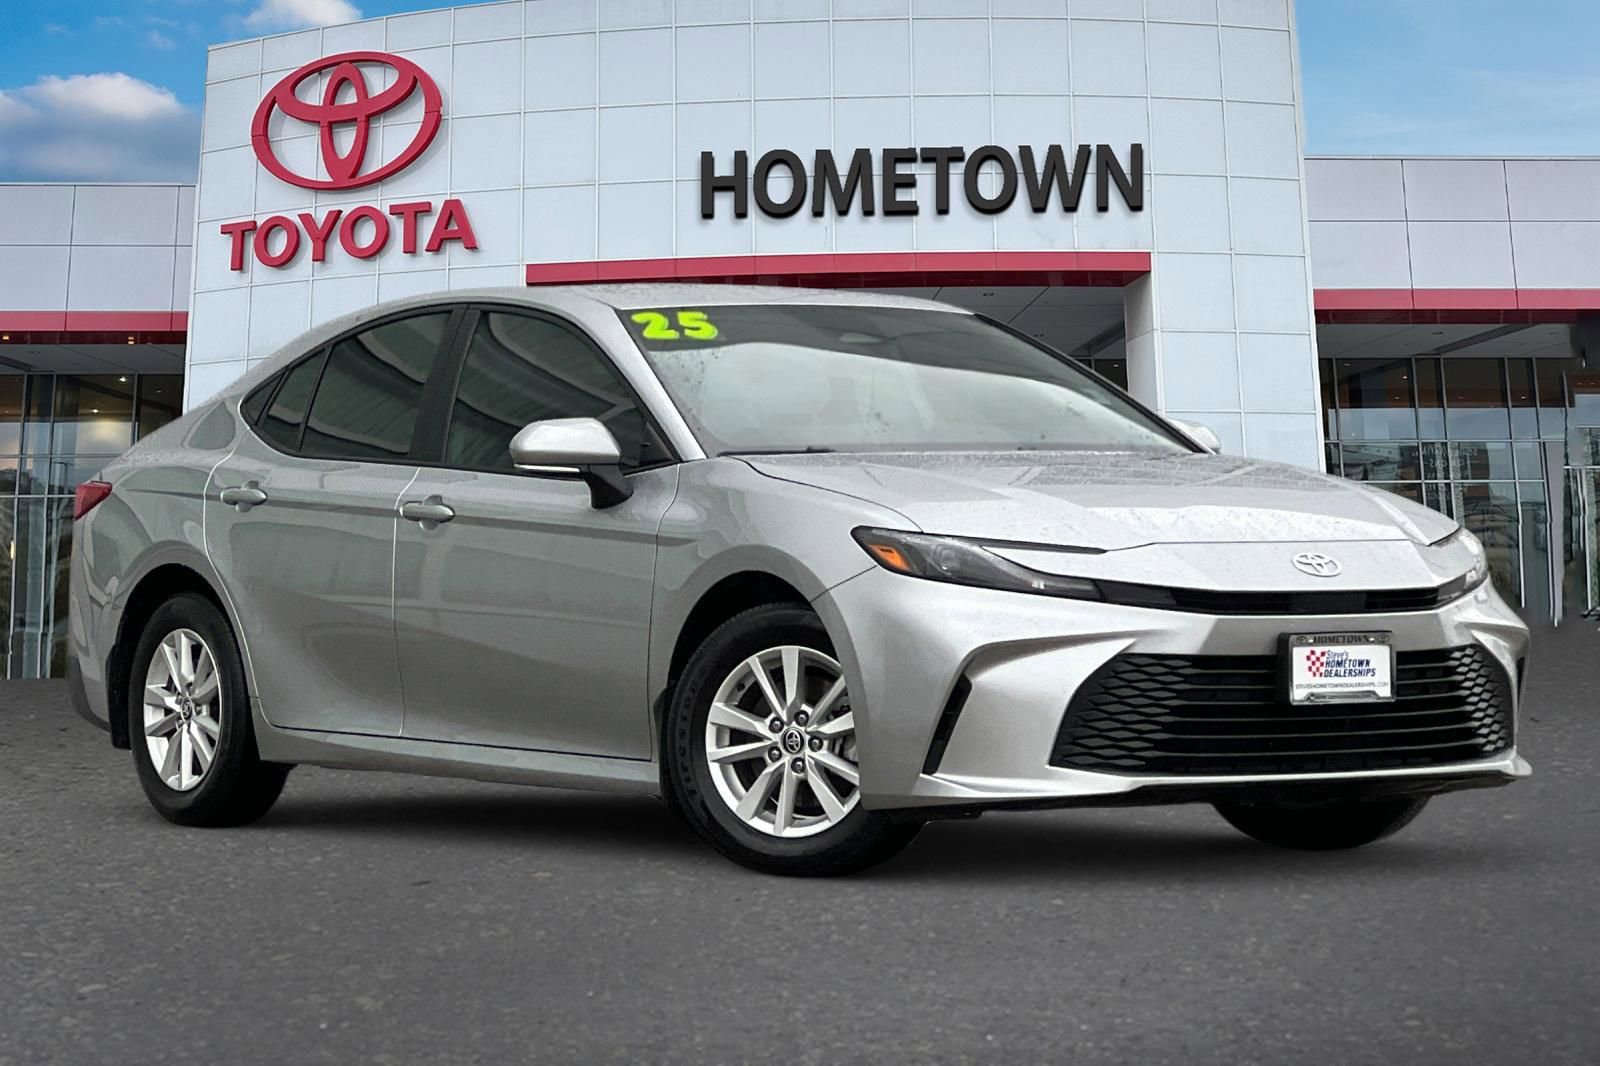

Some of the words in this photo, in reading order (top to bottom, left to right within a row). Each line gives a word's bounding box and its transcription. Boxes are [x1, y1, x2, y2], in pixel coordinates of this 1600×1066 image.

[700, 144, 1144, 219] HOMETOWN
[220, 198, 479, 271] TOYOTA
[630, 311, 718, 340] 25
[1314, 635, 1373, 643] HOMETOWN
[1326, 650, 1349, 660] Steve's
[1325, 659, 1371, 668] HOMETOWN
[1324, 668, 1377, 677] DEALERSHIPS
